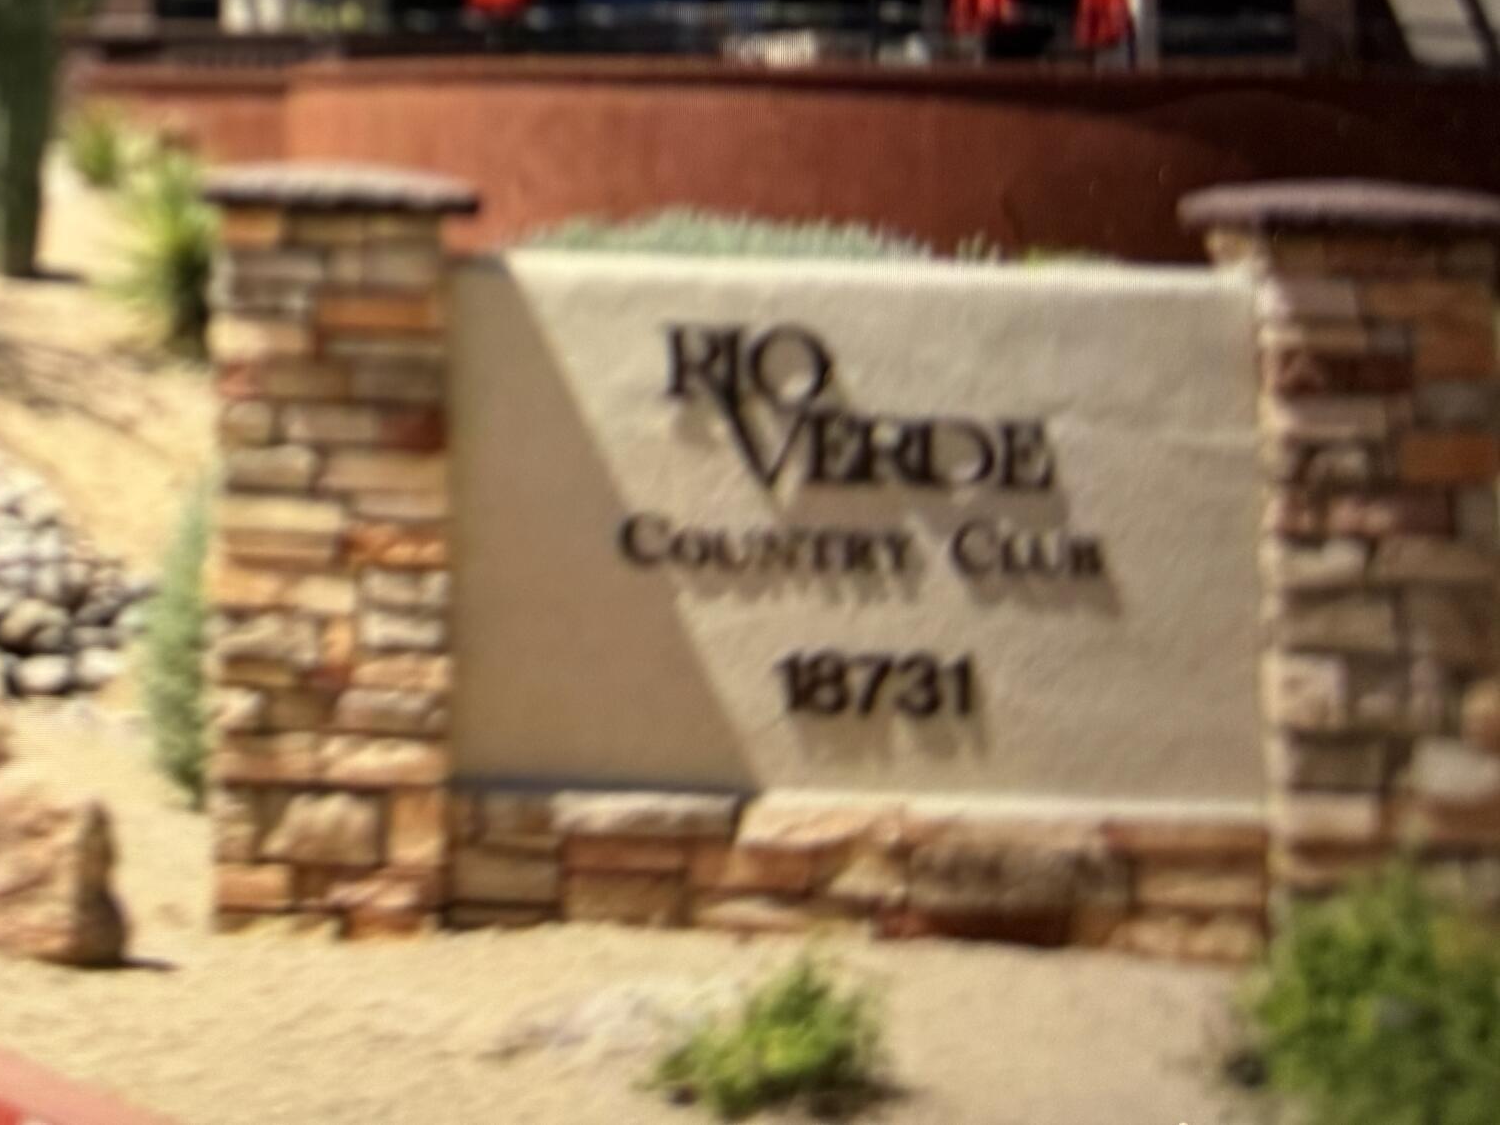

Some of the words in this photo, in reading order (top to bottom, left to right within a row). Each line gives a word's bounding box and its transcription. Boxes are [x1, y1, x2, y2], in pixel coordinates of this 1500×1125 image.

[666, 325, 831, 414] RIO
[707, 378, 1056, 491] VERDE
[618, 515, 913, 573] COUNTRY
[952, 518, 1105, 576] CLUB
[778, 651, 975, 717] 18731
